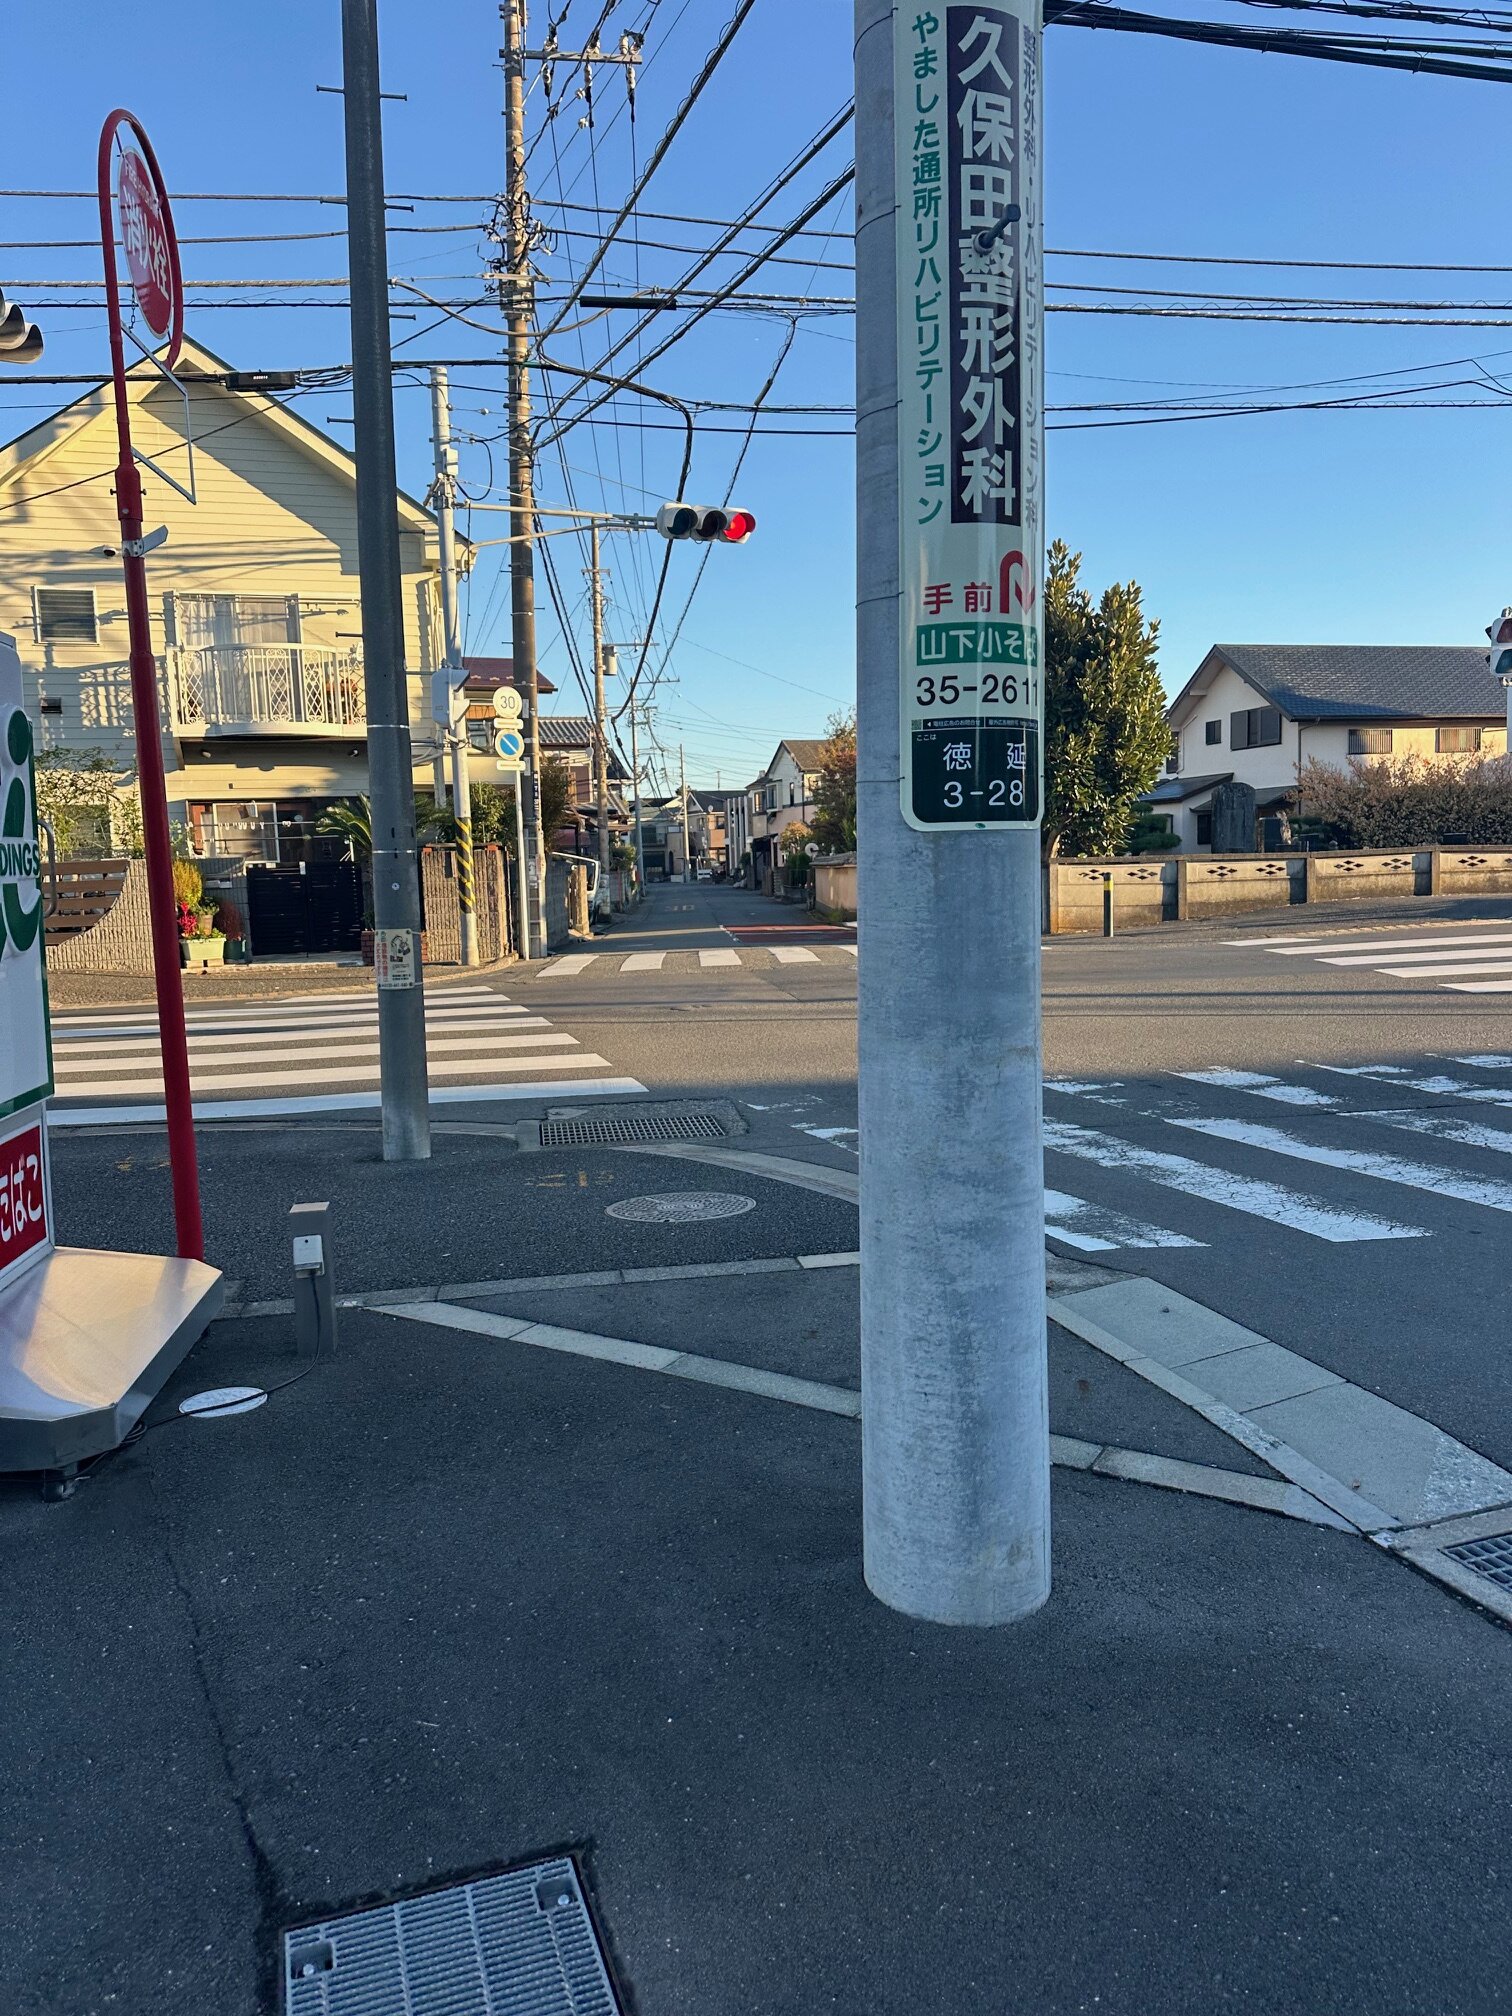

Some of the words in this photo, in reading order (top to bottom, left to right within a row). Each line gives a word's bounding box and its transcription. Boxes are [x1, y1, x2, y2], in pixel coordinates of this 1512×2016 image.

[911, 11, 945, 525] やました通所リハビリテーション
[956, 15, 1016, 517] 久保田整形外科
[923, 581, 993, 614] 手前
[920, 627, 1037, 661] 山下小そば
[500, 695, 516, 710] 30
[916, 673, 1038, 706] 35-2611
[916, 734, 937, 742] ここは
[942, 741, 1027, 771] 徳延
[943, 779, 1023, 808] 3-28
